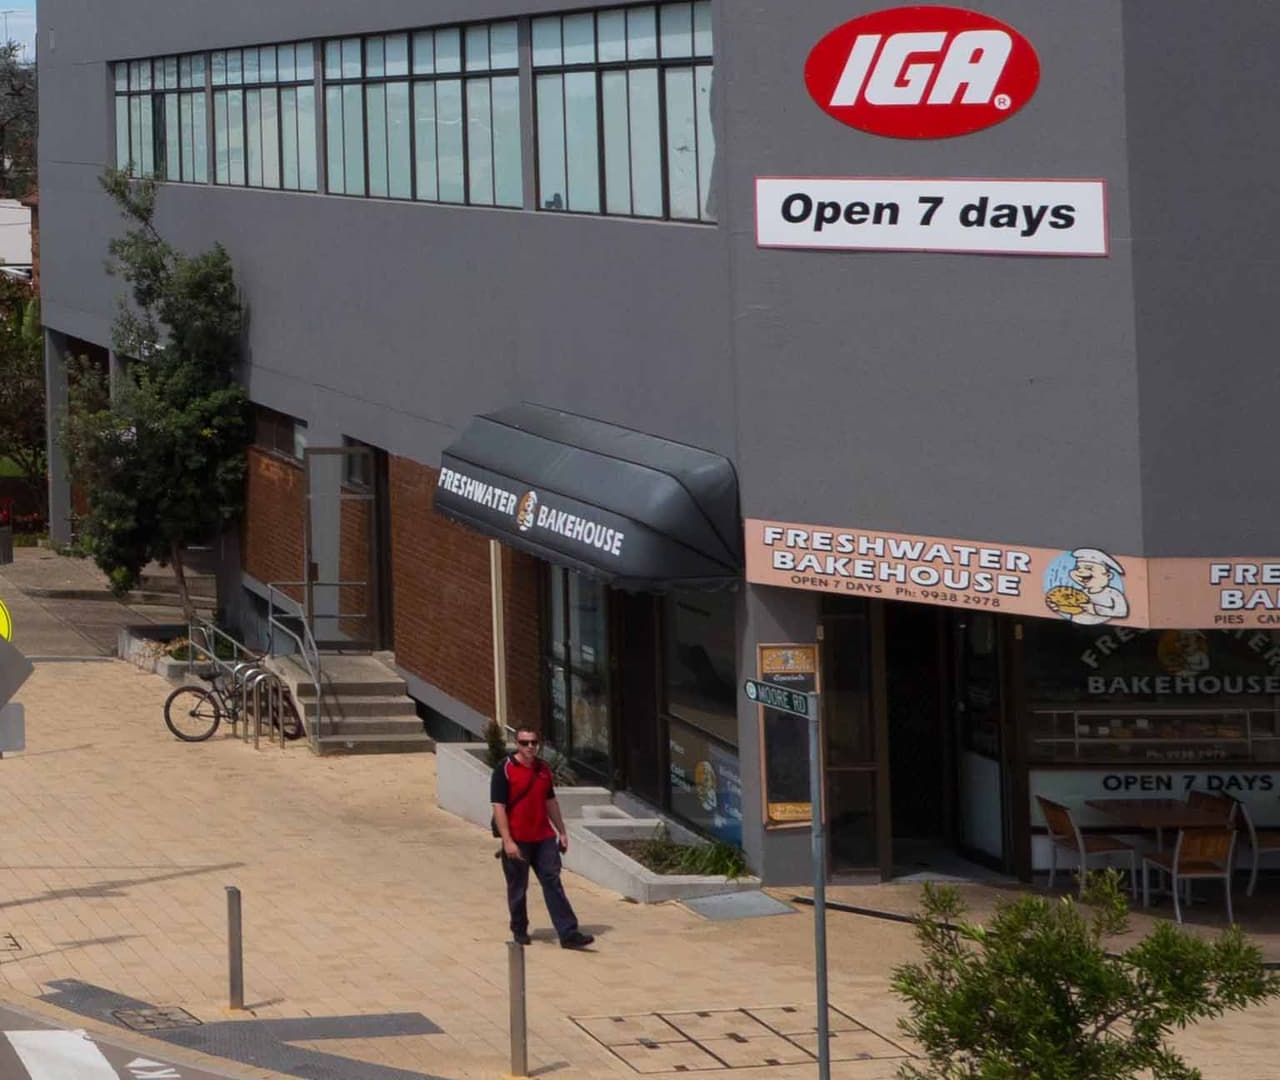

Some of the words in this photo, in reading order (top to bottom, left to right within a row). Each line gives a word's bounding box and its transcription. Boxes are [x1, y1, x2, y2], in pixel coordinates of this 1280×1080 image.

[830, 29, 1013, 107] IGA
[780, 192, 900, 232] Open
[917, 195, 944, 226] 7
[958, 196, 1077, 237] days
[438, 466, 518, 516] FRESHWATER
[536, 503, 624, 556] BAKEHOUSE
[762, 525, 1032, 574] FRESHWATER
[772, 549, 1021, 597] BAKEHOUSE
[790, 575, 829, 588] OPEN
[833, 580, 841, 589] 7
[846, 581, 883, 594] DAYS
[895, 587, 916, 598] Ph:
[920, 590, 958, 602] 9938
[963, 594, 1001, 607] 2978
[1220, 588, 1280, 611] BA
[1214, 614, 1244, 624] PIES
[758, 683, 791, 710] MOORE
[792, 692, 807, 715] RD
[1087, 675, 1280, 695] BAKEHOUSE
[1102, 775, 1172, 791] OPEN
[1183, 775, 1196, 791] 7
[1208, 775, 1274, 791] DAYS
